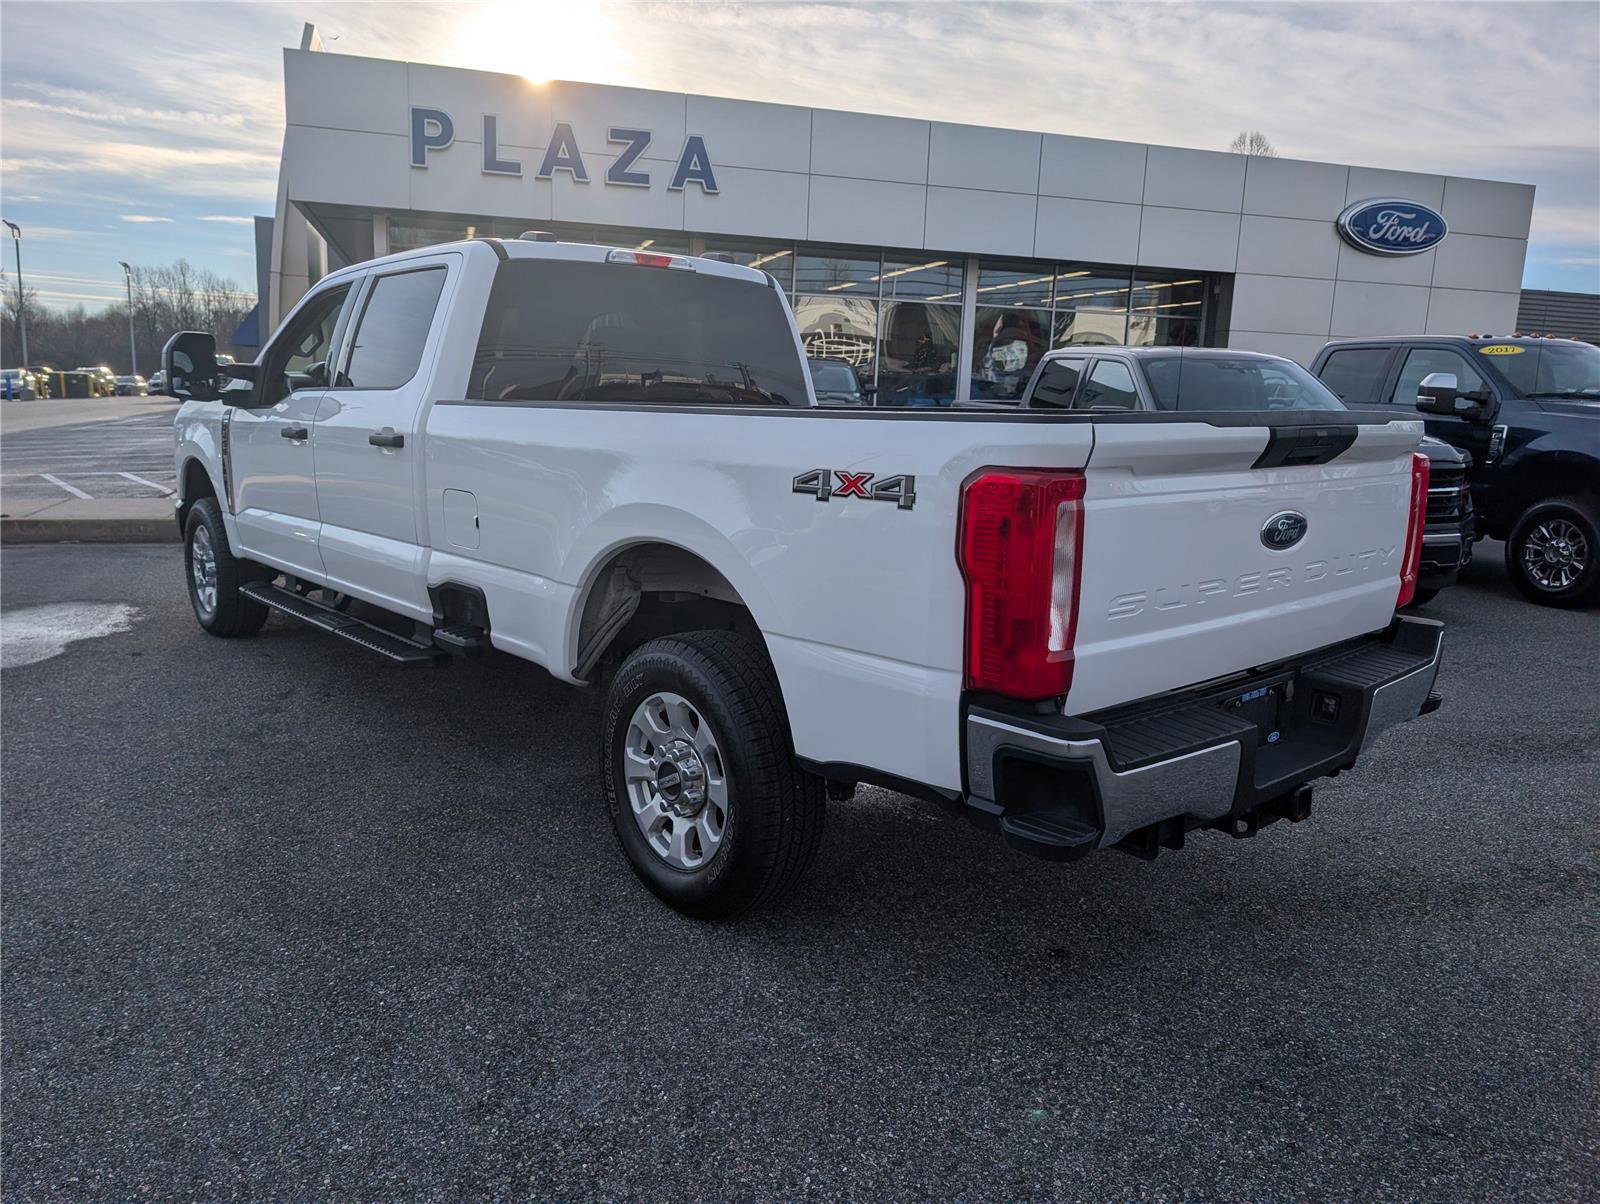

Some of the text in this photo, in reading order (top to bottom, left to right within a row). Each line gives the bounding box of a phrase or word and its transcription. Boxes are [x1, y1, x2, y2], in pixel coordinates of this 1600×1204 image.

[409, 105, 720, 194] PLAZA
[1369, 209, 1430, 242] Ford
[1488, 346, 1515, 354] 2017
[1274, 519, 1301, 542] Ford
[1107, 545, 1397, 621] SUPER DUTY
